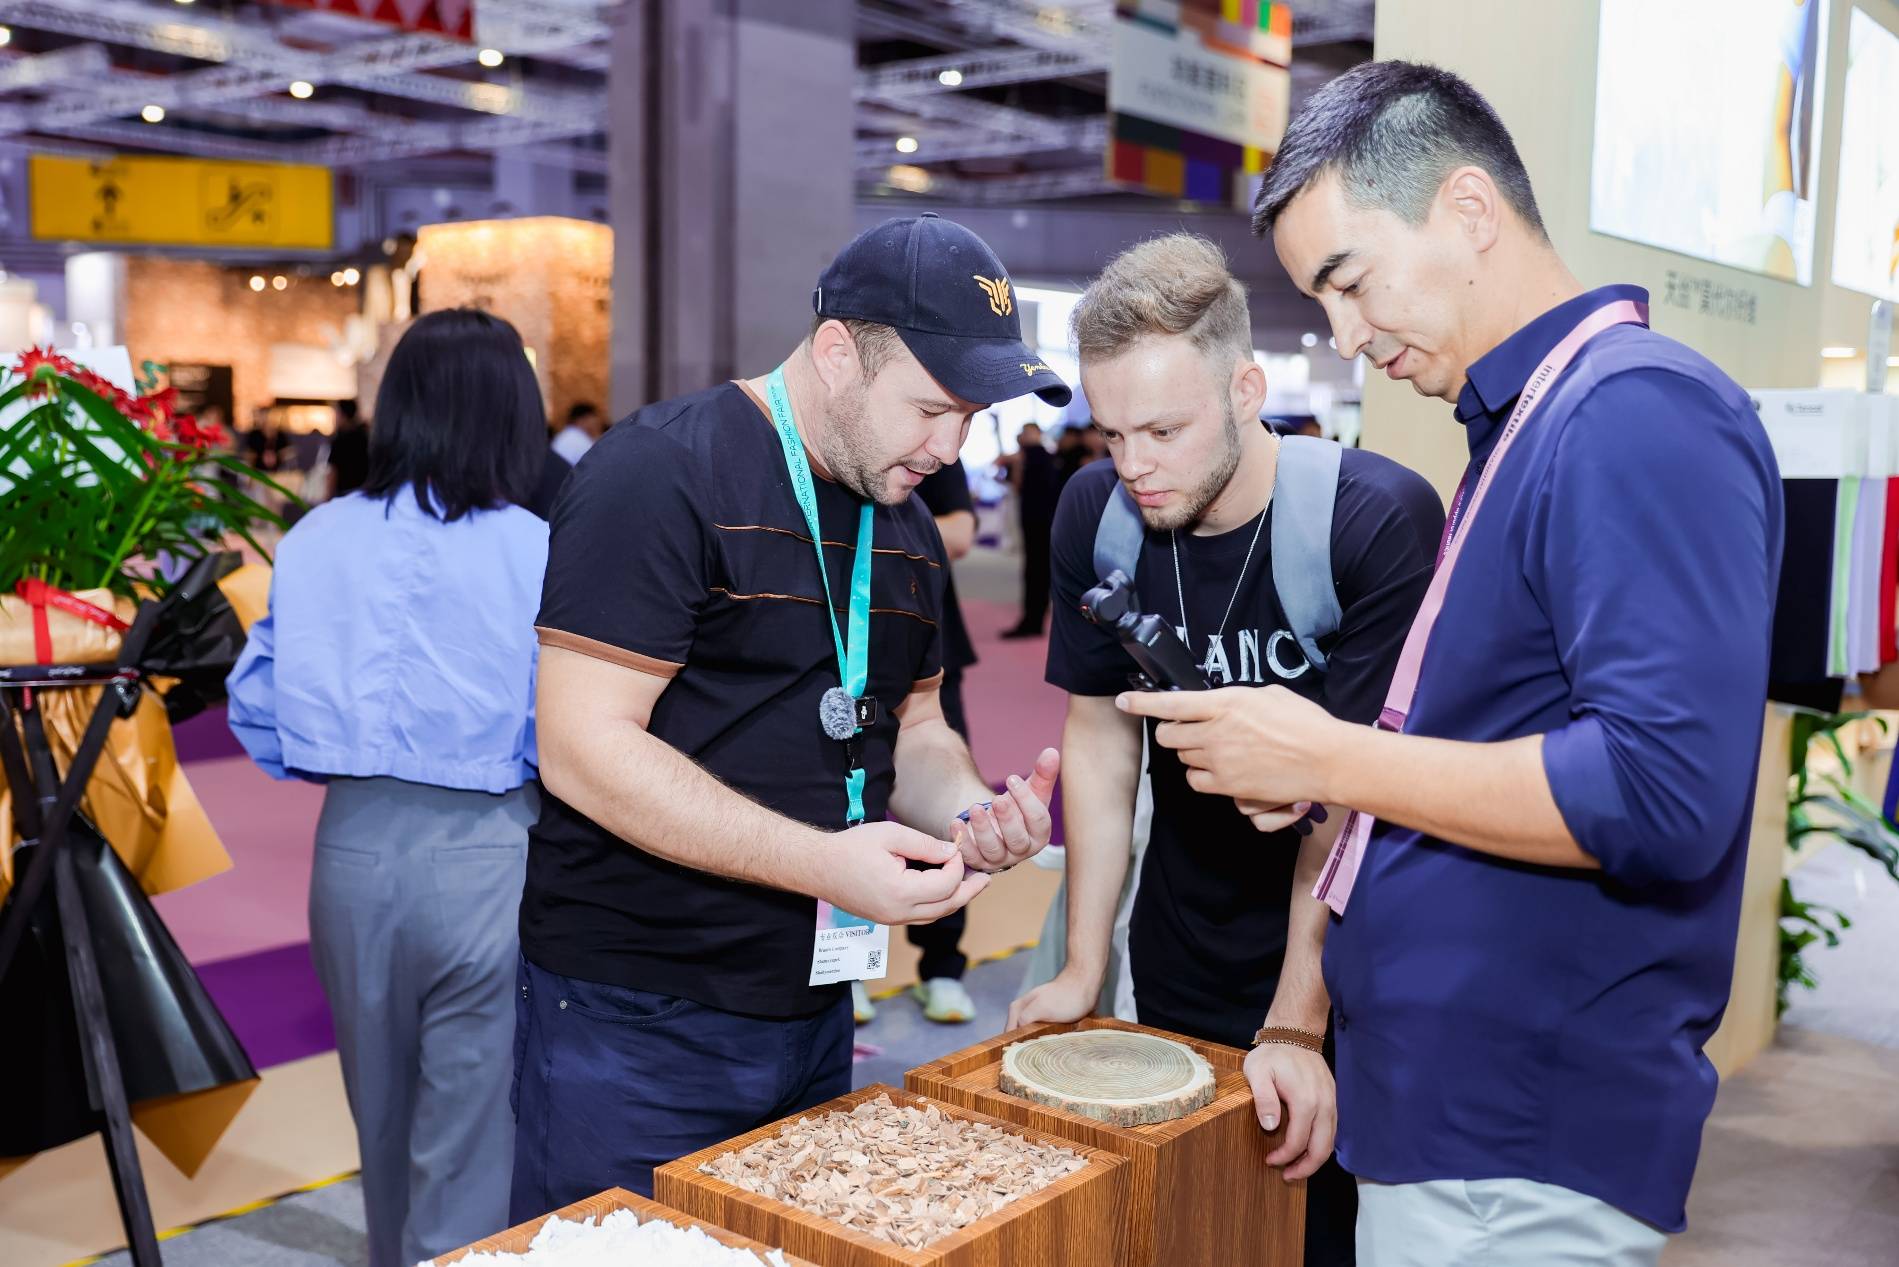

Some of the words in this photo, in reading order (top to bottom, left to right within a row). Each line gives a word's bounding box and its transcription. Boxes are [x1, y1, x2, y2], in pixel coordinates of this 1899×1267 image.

[775, 399, 786, 418] FAIR
[1502, 364, 1555, 442] intertextile
[780, 419, 798, 457] FASHION
[1175, 627, 1311, 684] ANC
